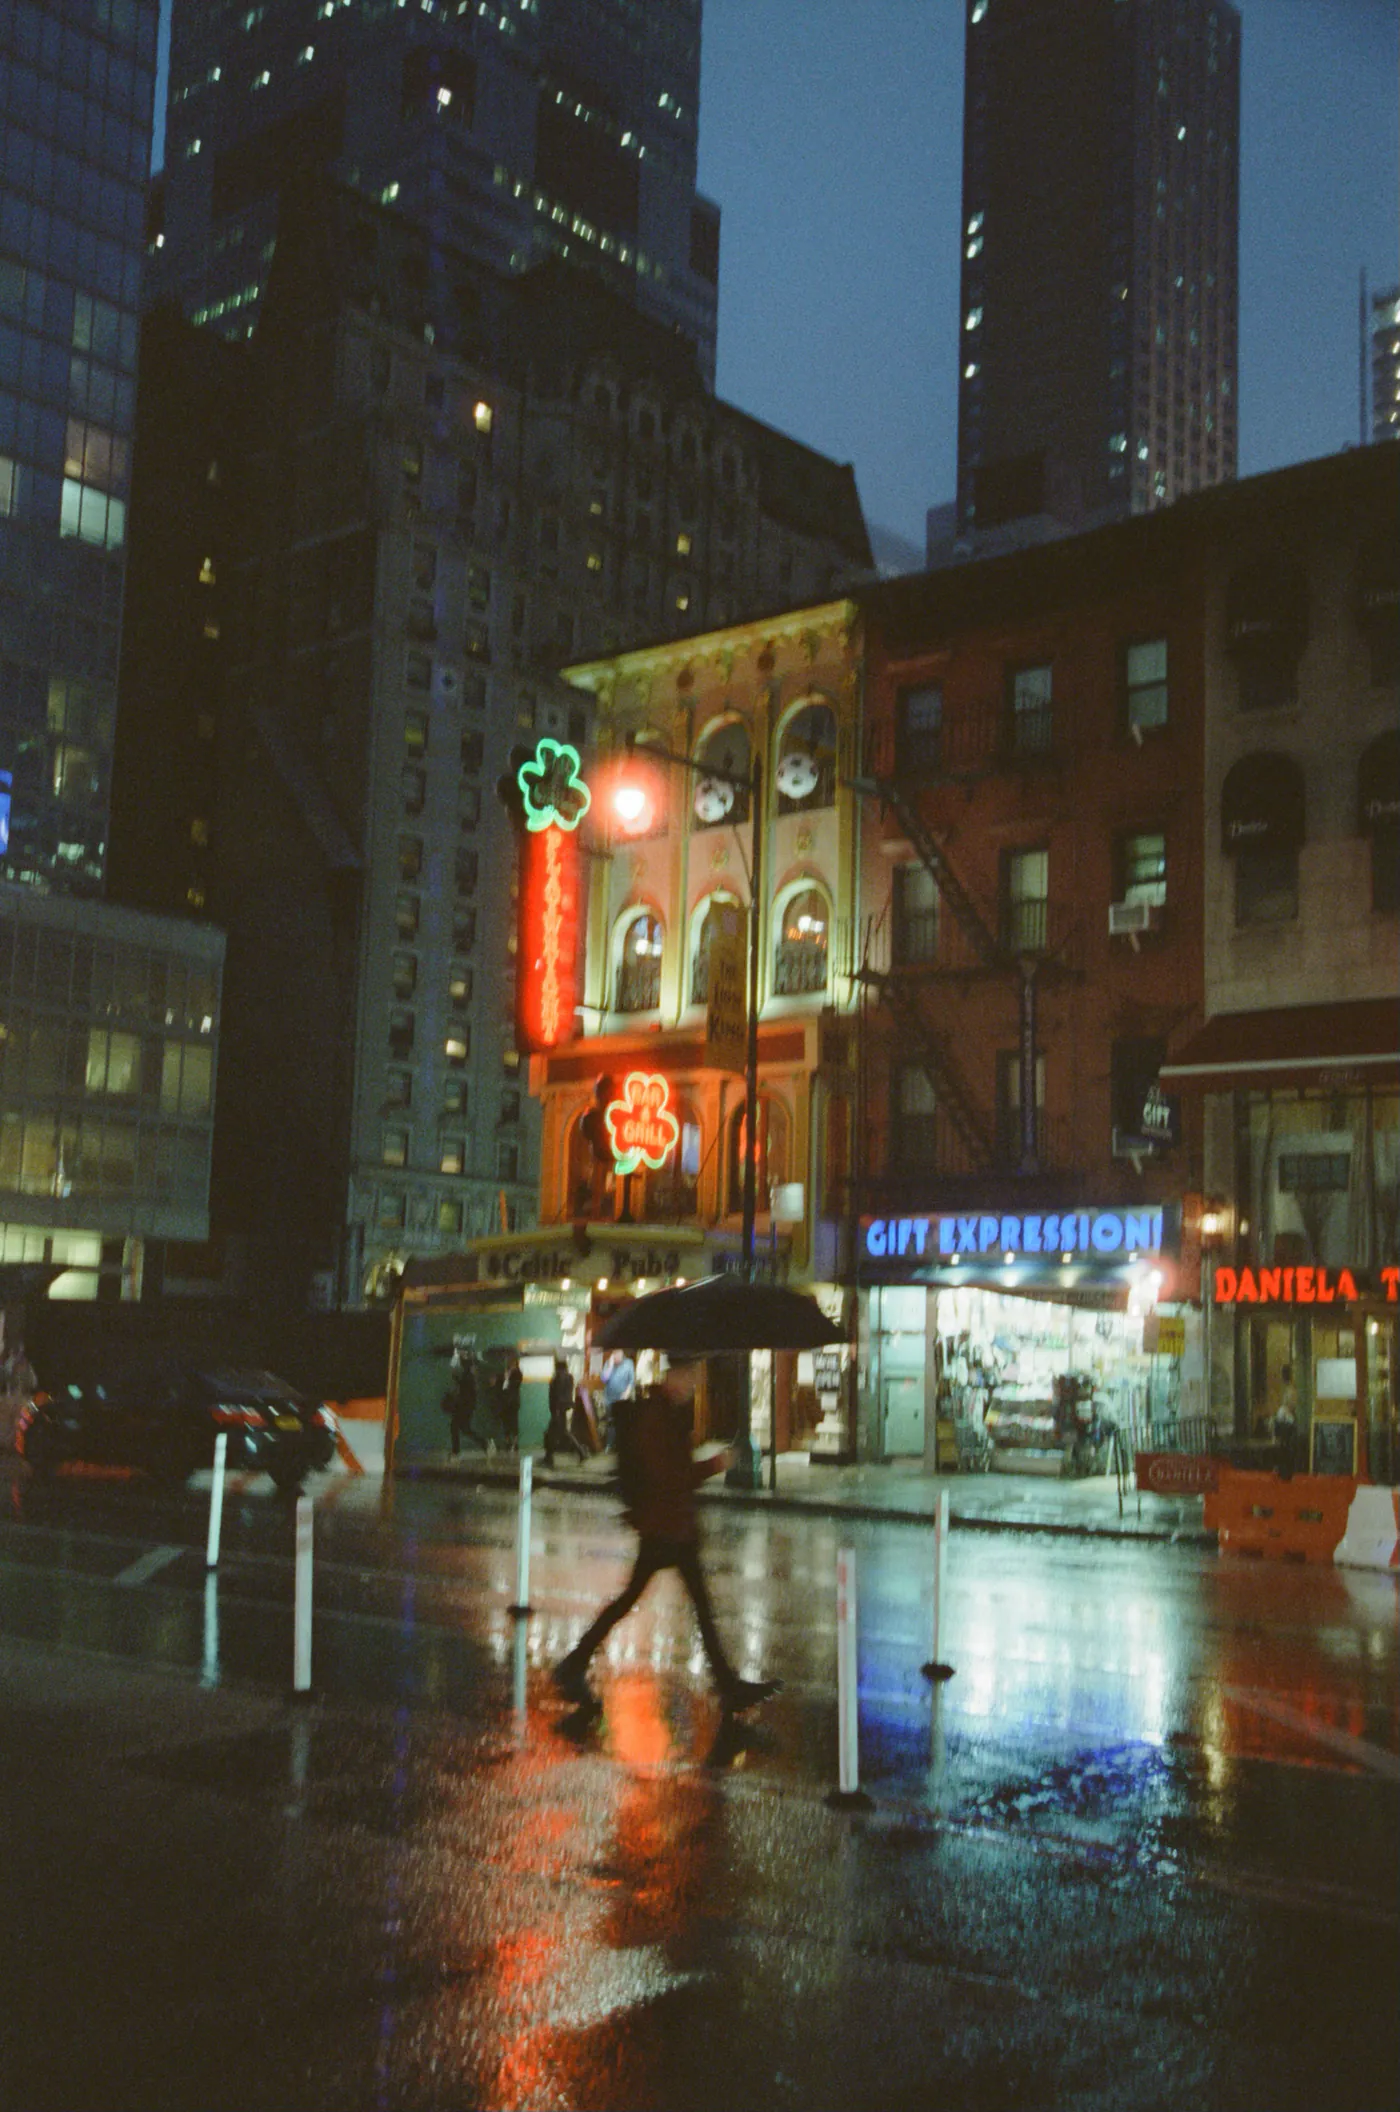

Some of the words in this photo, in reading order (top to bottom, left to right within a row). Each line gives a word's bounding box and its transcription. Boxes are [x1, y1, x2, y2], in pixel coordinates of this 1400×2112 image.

[866, 1218, 929, 1256] GIFT
[612, 1249, 663, 1279] Pub
[1214, 1265, 1359, 1303] DANIELA
